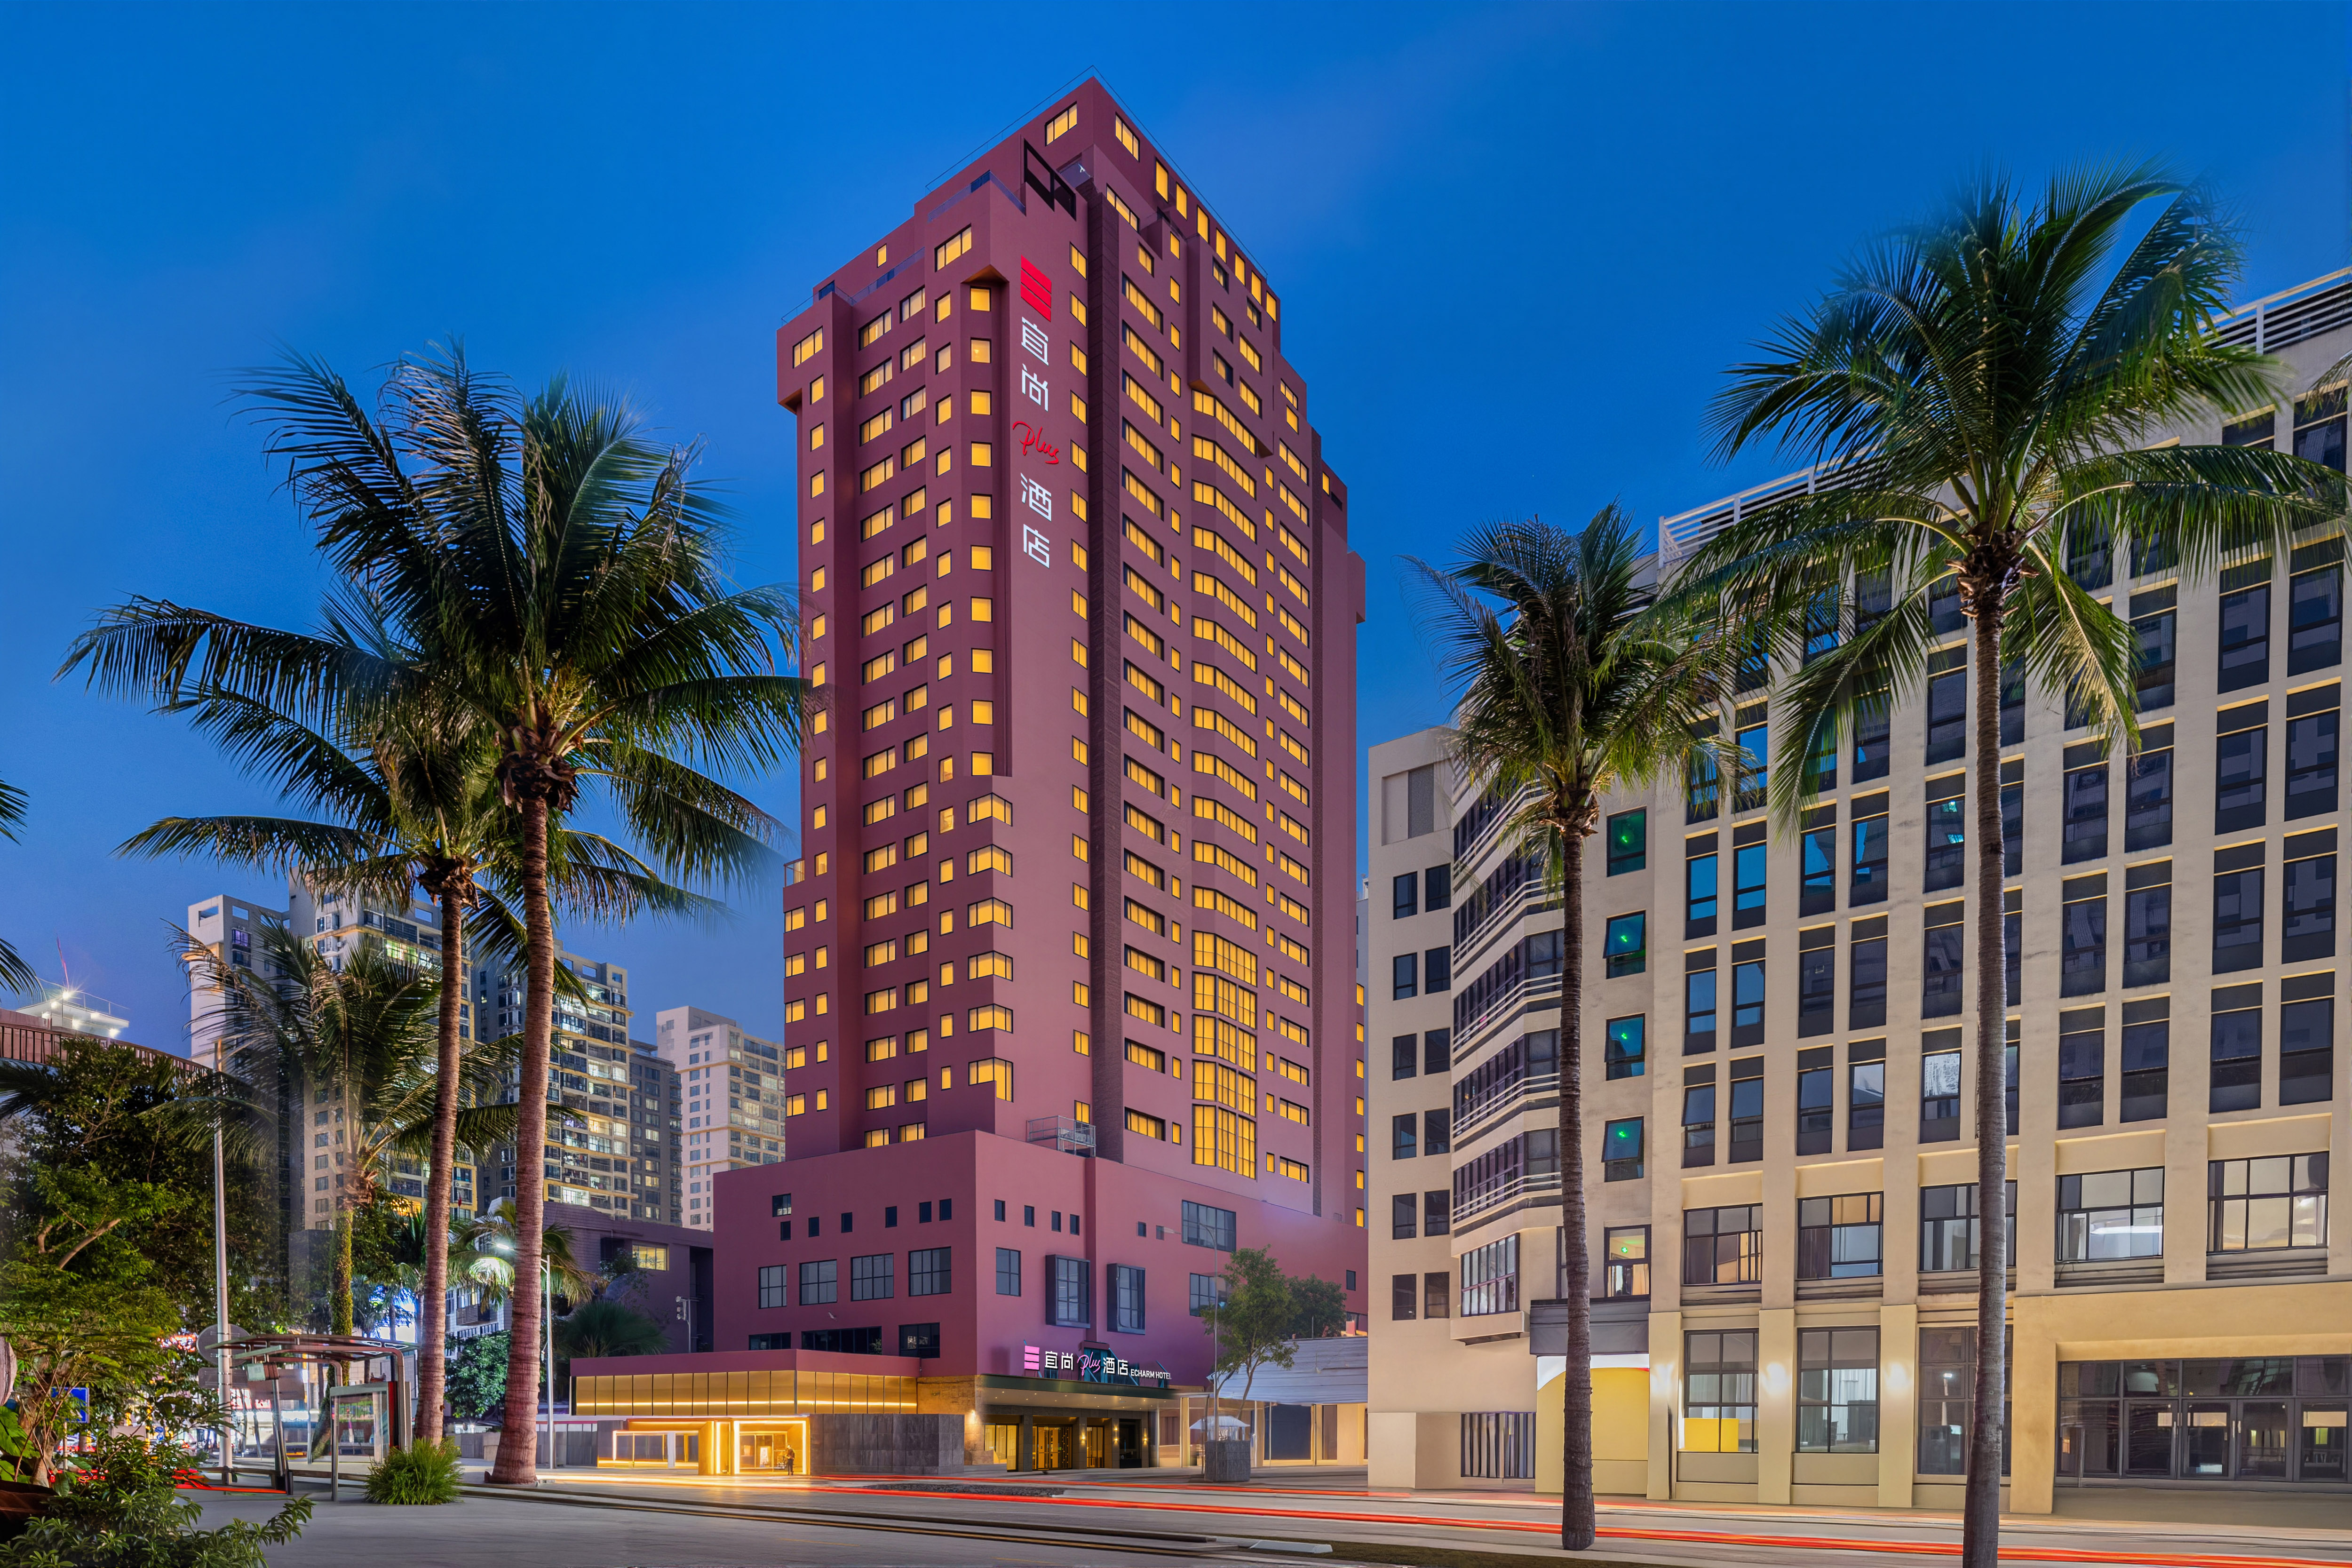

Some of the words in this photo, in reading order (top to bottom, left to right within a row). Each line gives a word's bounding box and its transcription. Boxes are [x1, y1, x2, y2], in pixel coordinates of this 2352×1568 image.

[1021, 316, 1049, 412] 宜尚
[1020, 472, 1052, 569] 酒店
[1045, 1351, 1073, 1370] 宜尚
[1103, 1357, 1128, 1376] 酒店
[1130, 1369, 1155, 1378] ECHARM
